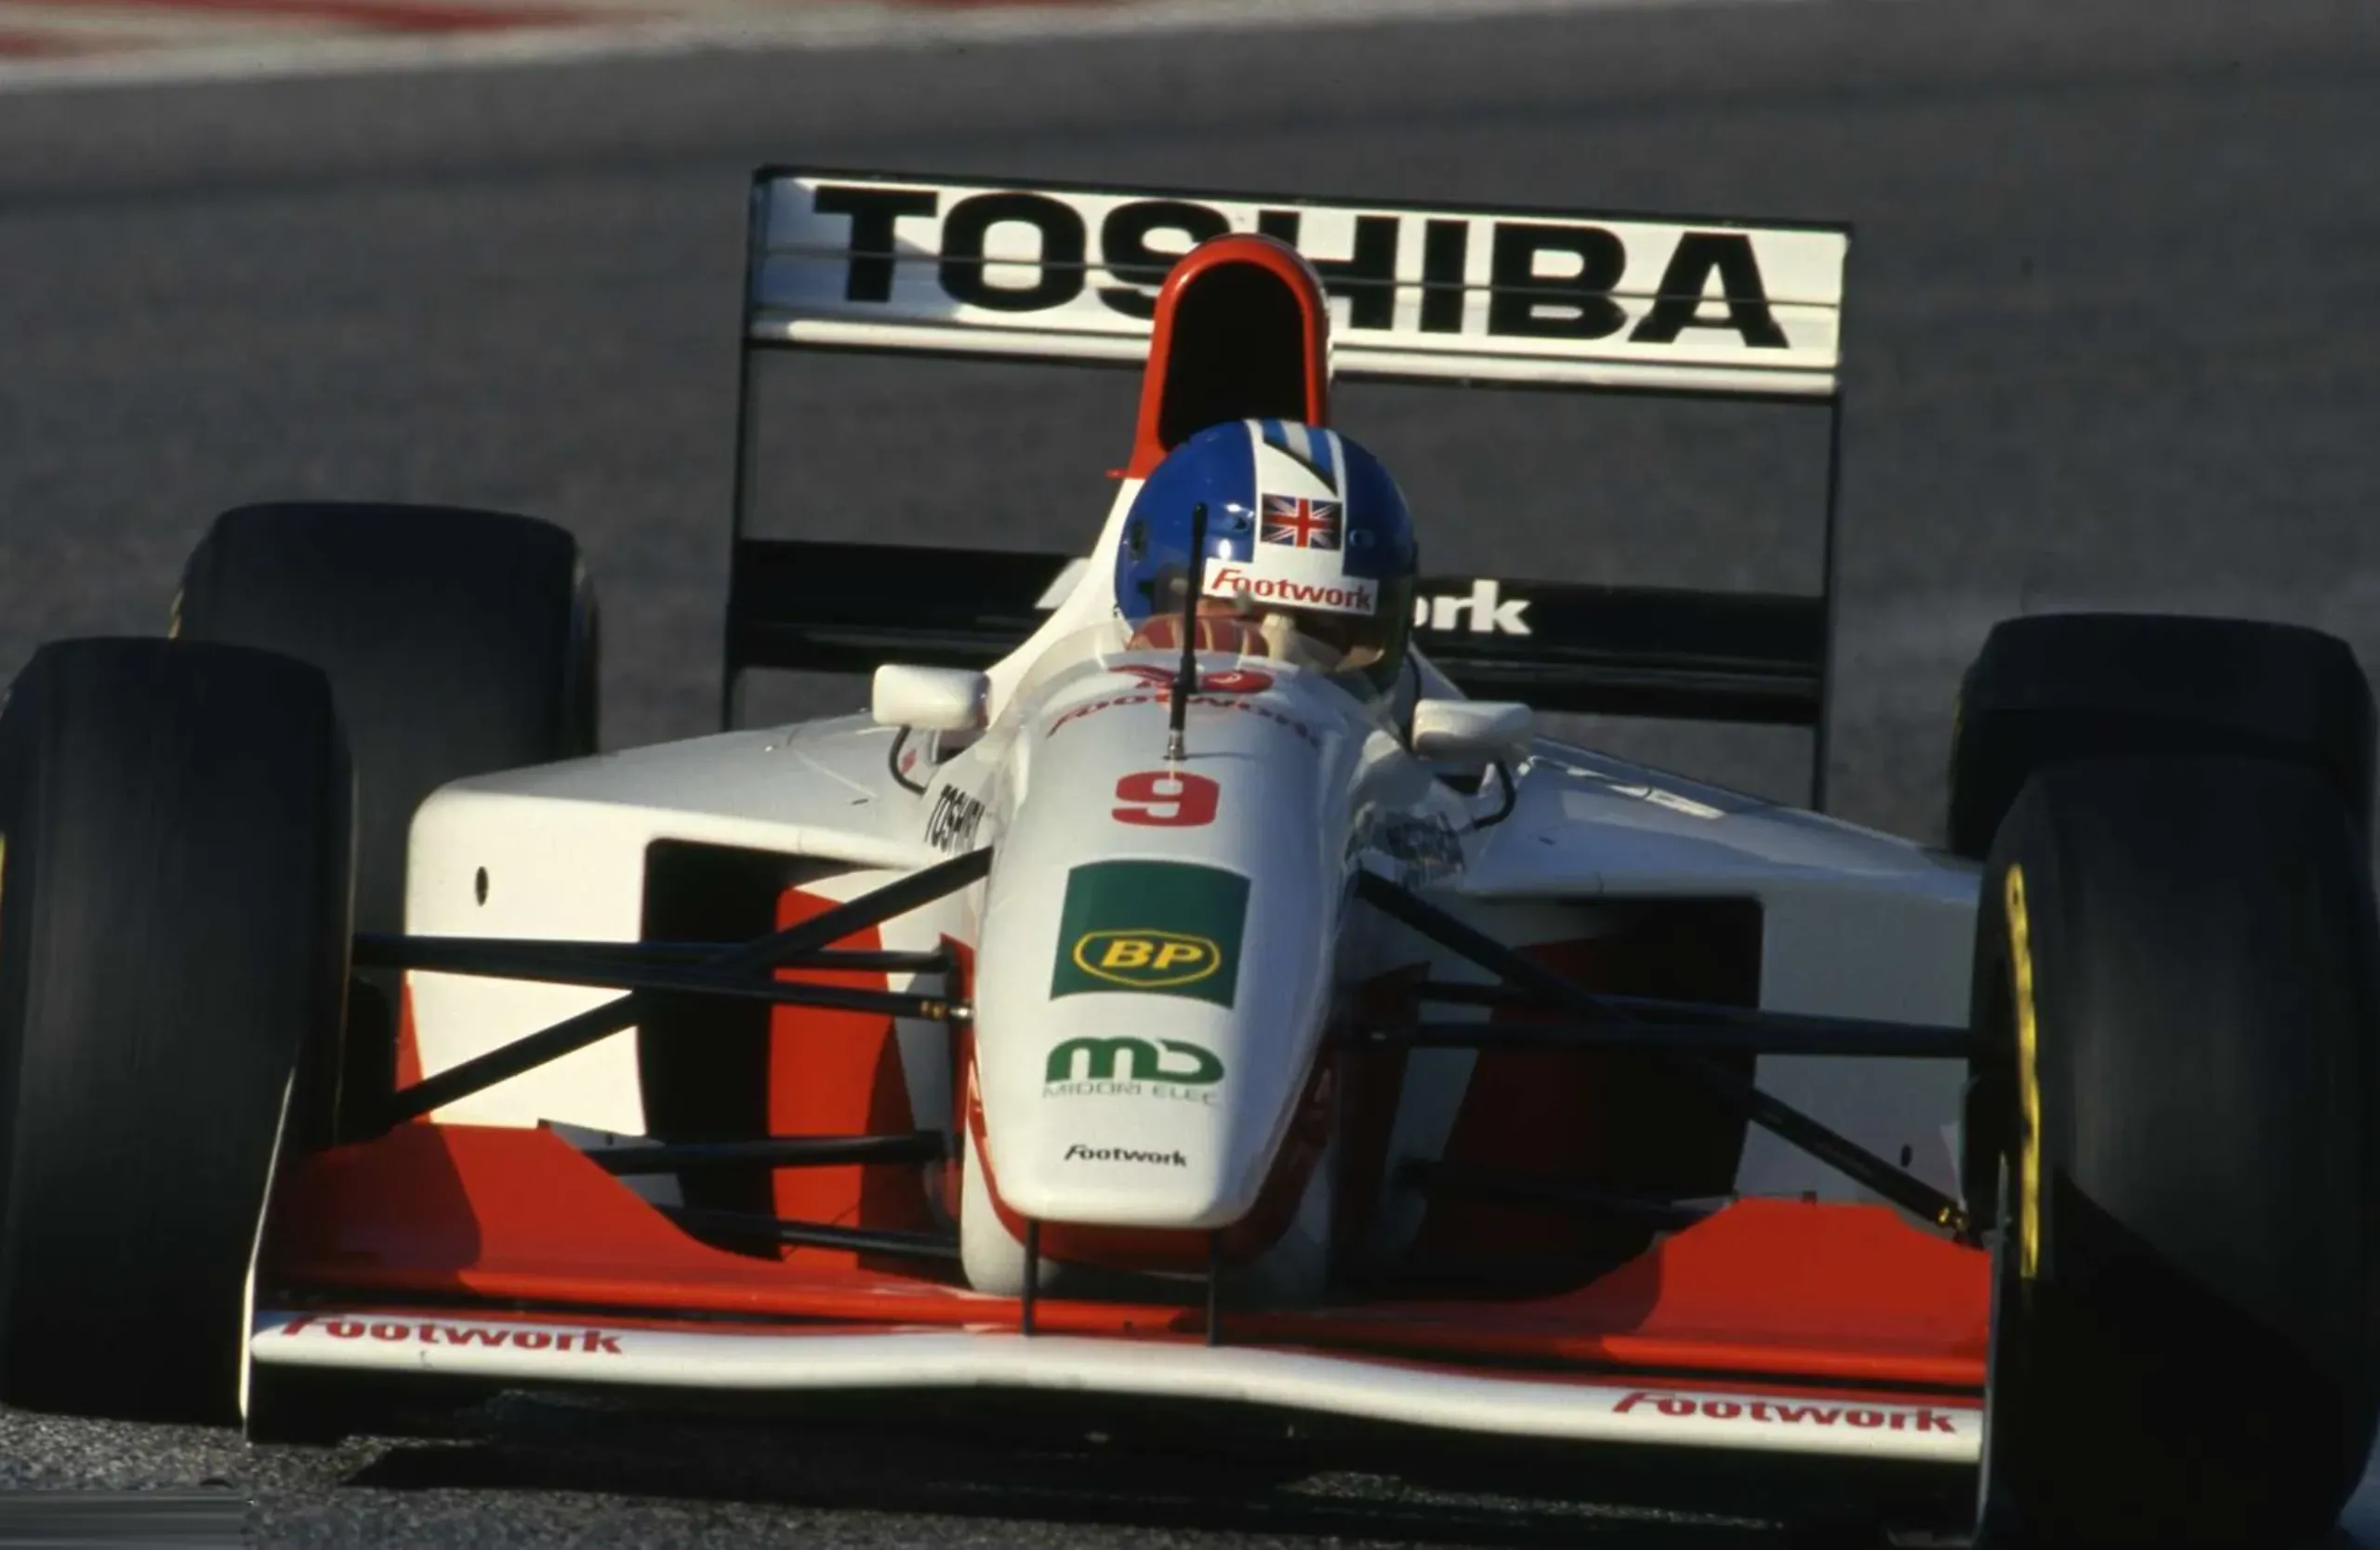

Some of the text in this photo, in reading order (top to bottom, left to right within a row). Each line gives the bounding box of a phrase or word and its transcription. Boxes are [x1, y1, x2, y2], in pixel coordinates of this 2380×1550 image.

[813, 185, 1791, 349] TOSHIBA
[1210, 566, 1373, 612] Footwork
[1111, 770, 1221, 828] 9
[1102, 941, 1203, 969] BP
[1064, 1144, 1187, 1167] Footwork
[282, 1315, 622, 1354] Footwork
[1612, 1392, 1956, 1433] Footwork
